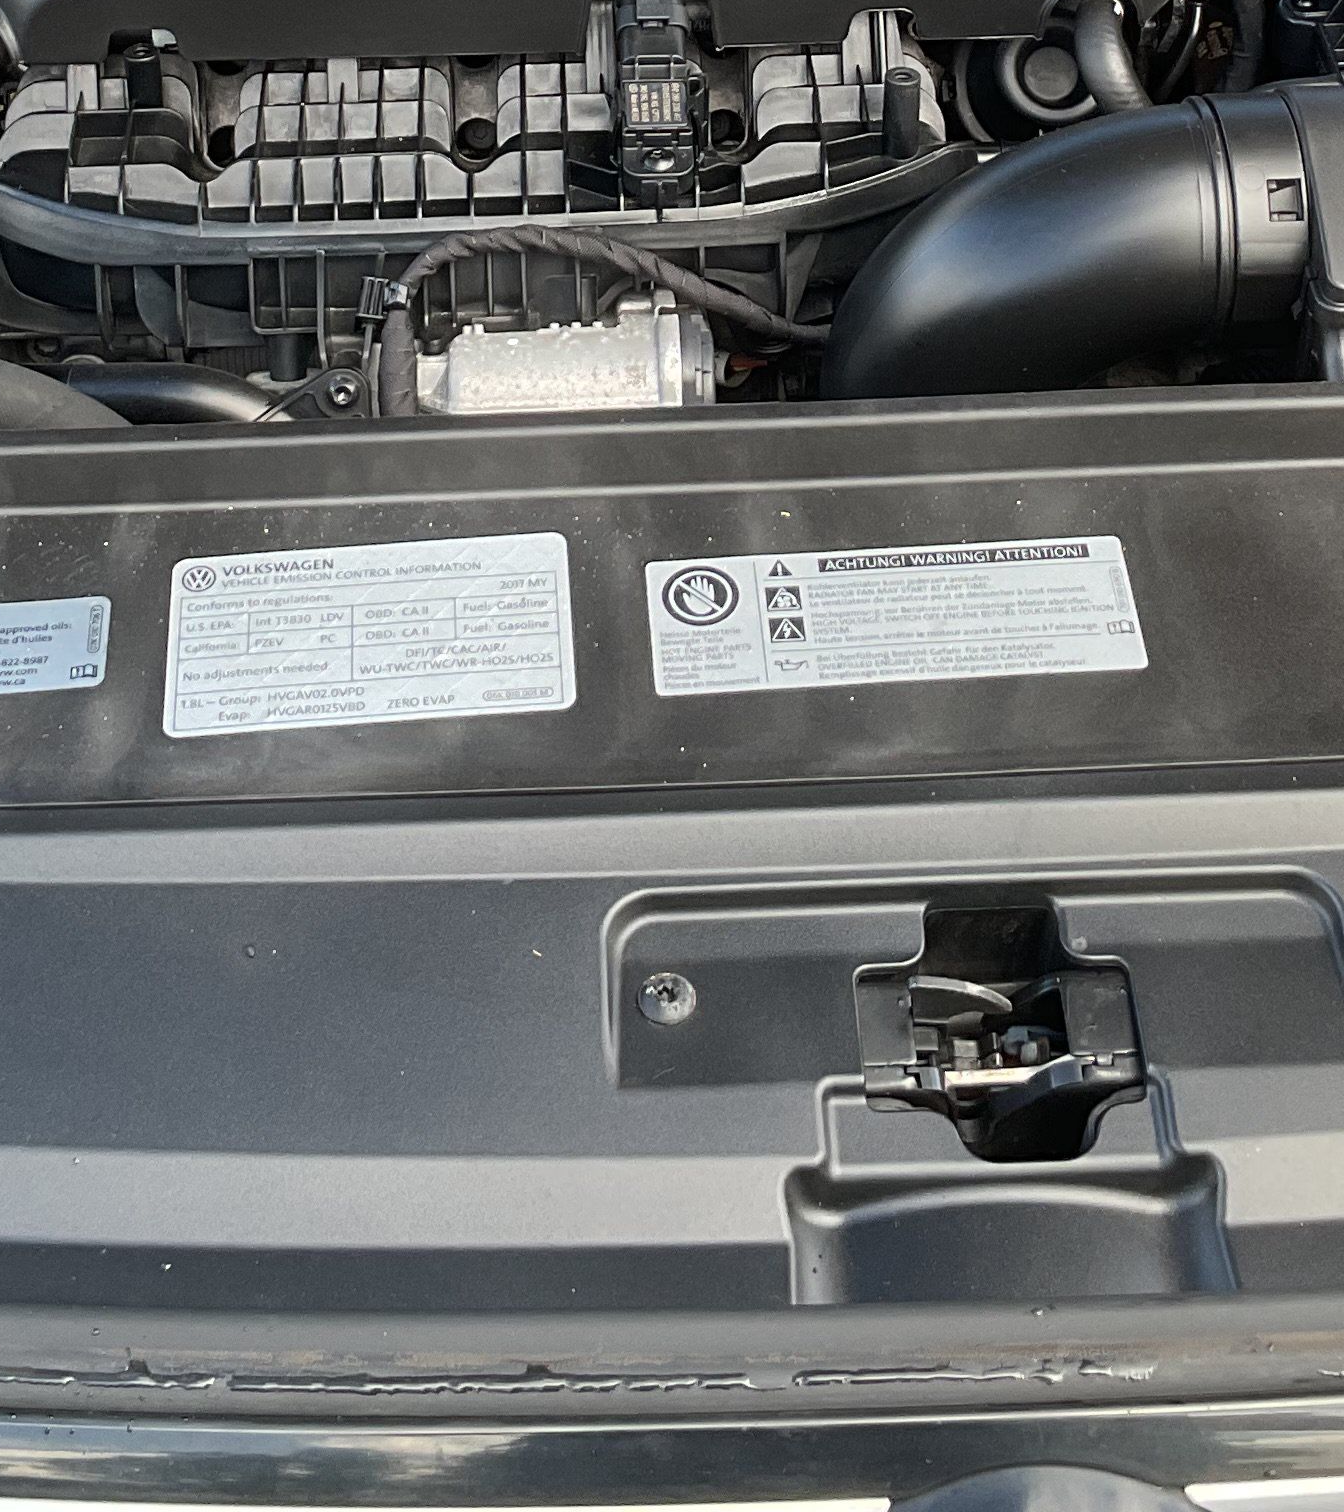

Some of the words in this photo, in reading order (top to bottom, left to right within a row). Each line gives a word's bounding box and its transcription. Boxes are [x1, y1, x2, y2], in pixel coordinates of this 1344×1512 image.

[824, 556, 906, 571] ACHTUNG!
[911, 552, 990, 566] WARNING!
[993, 547, 1084, 562] ATTENTION!
[221, 558, 334, 577] VOLKSWAGEN
[221, 576, 270, 589] VEHICLE
[274, 572, 331, 585] EMISSION
[336, 567, 390, 580] CONTROL
[396, 561, 482, 576] INFORMATION
[500, 579, 525, 590] 2017
[528, 577, 548, 588] MY
[187, 599, 245, 613] Conforms
[247, 598, 260, 609] to
[498, 597, 549, 610] Gasoline
[0, 623, 49, 634] approved
[498, 618, 550, 631] Gasoline
[254, 637, 285, 648] PZEV
[320, 633, 336, 644] PC
[182, 670, 200, 684] No
[203, 665, 279, 682] adjustments
[283, 661, 328, 677] needed
[387, 696, 420, 709] ZERO
[423, 694, 456, 706] EVAP
